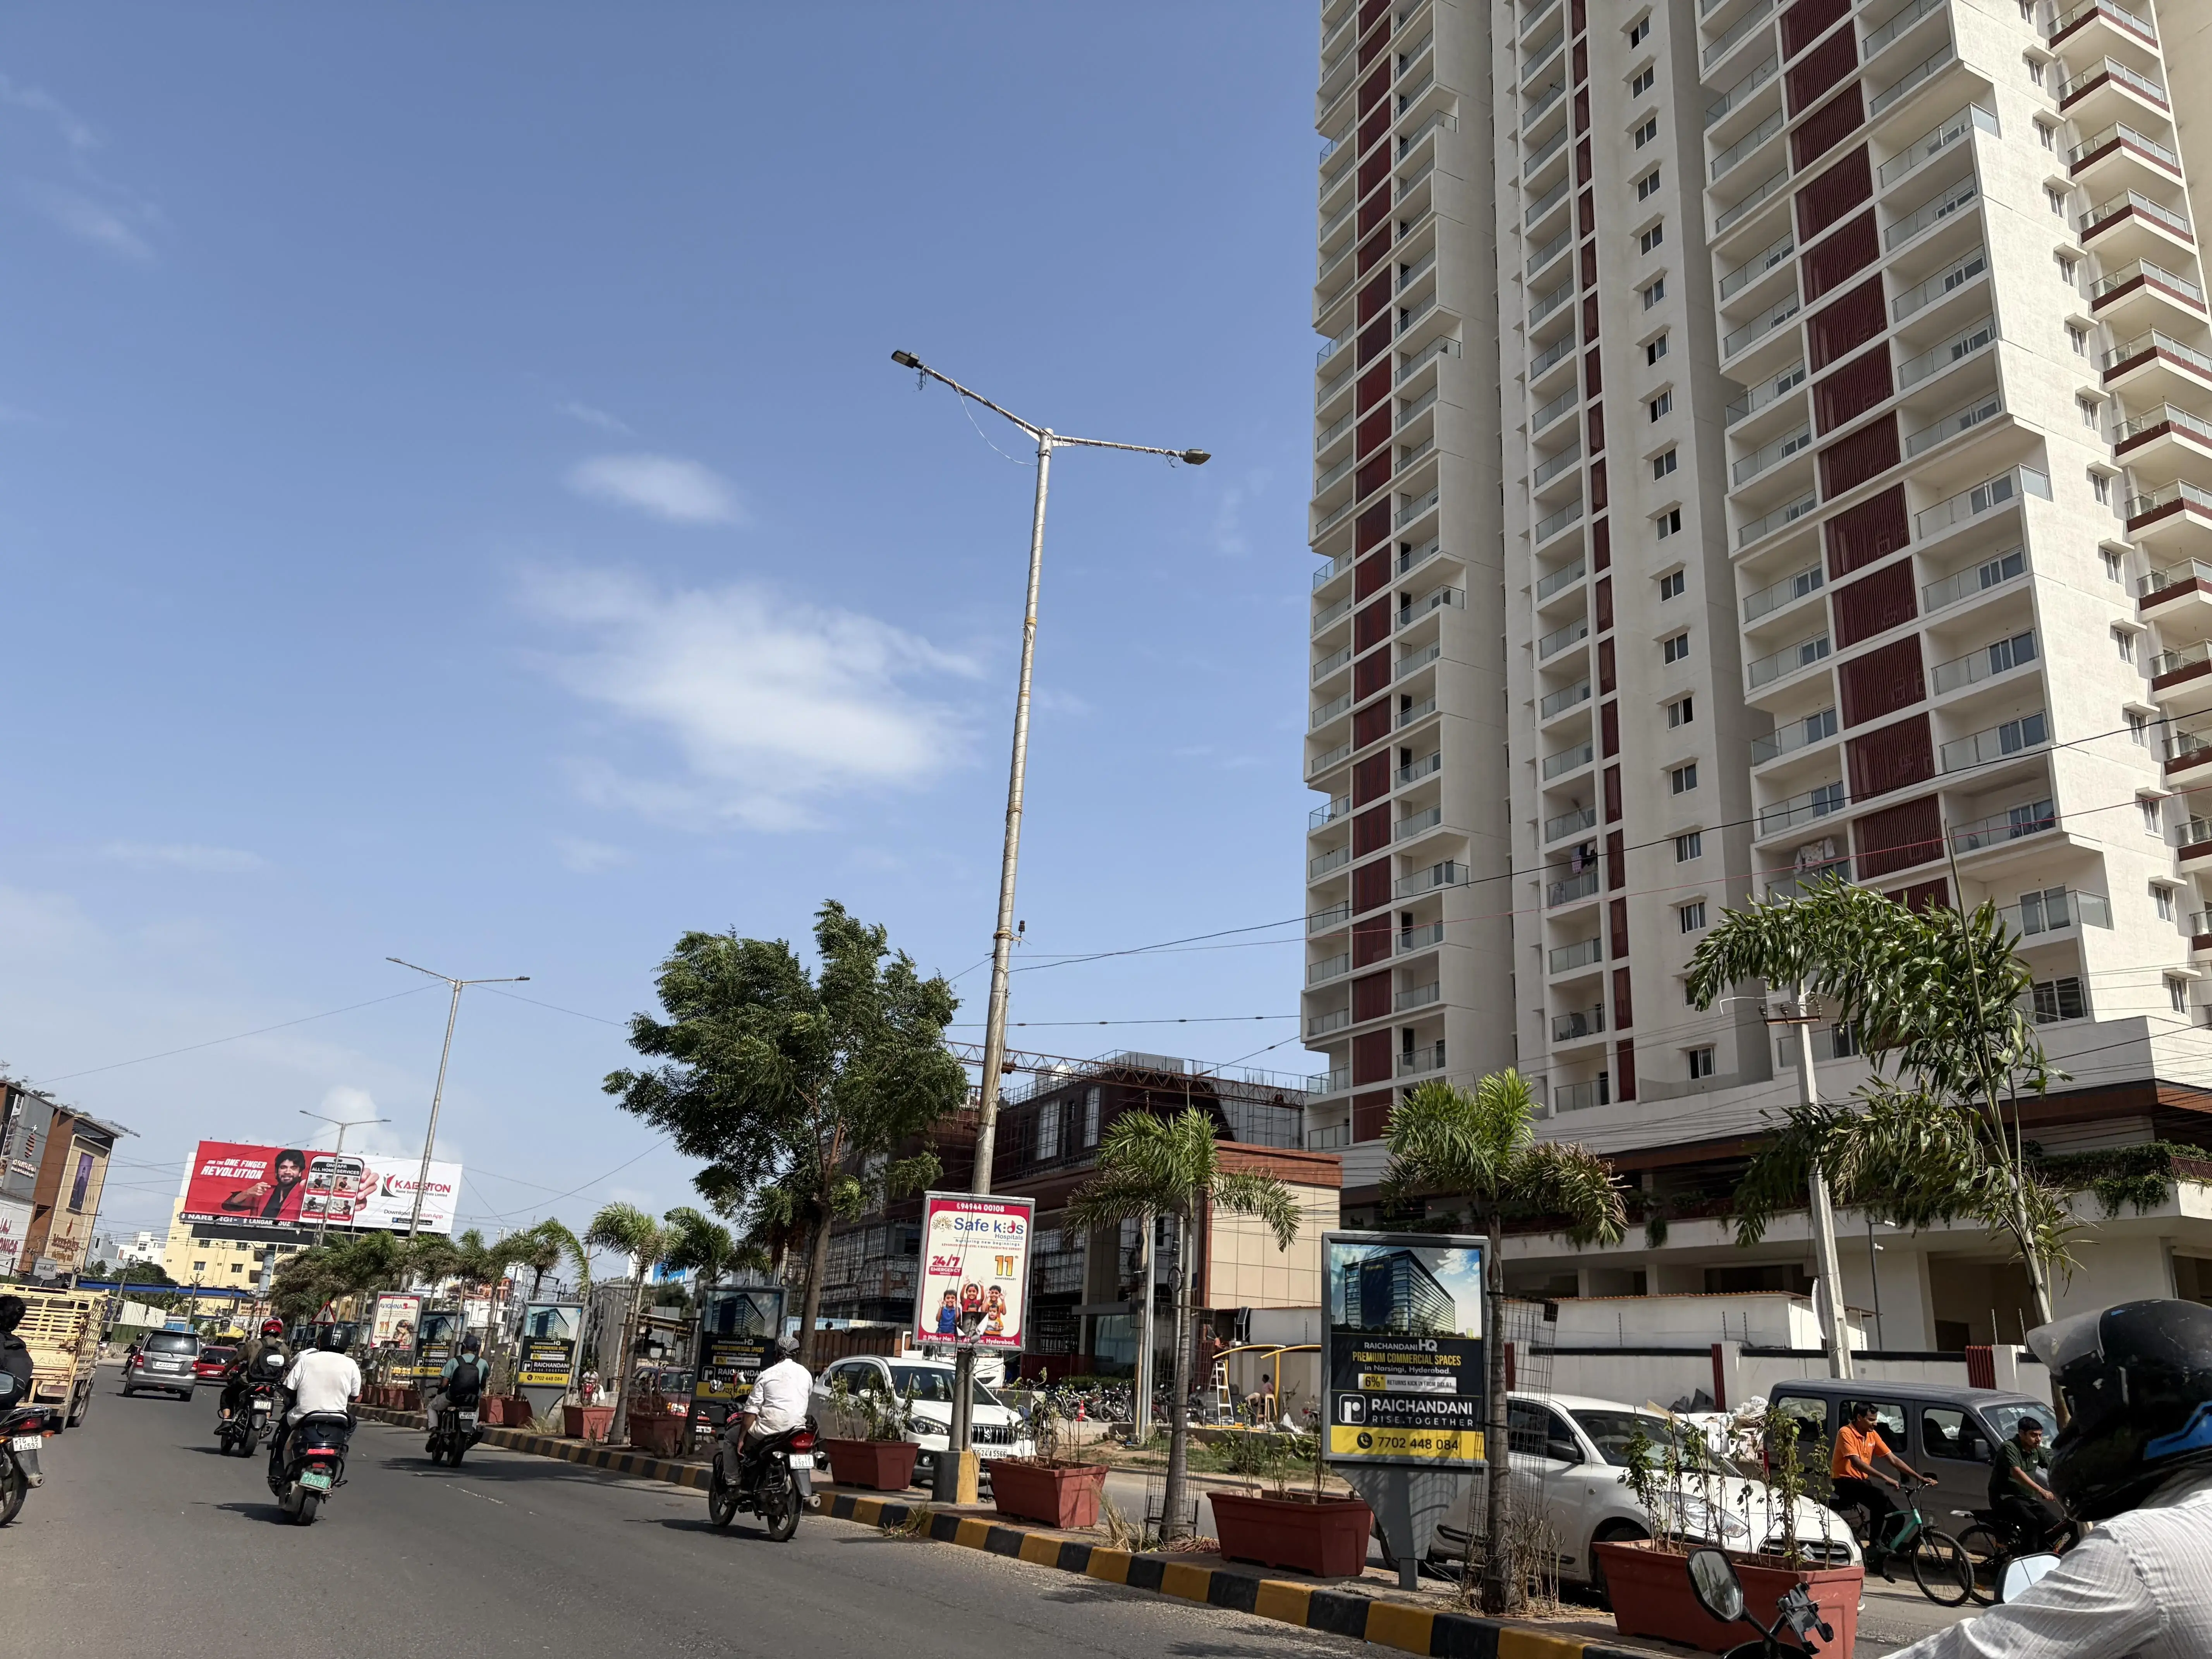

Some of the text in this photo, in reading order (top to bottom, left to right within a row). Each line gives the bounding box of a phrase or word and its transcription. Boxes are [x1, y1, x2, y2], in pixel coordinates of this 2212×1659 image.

[240, 1160, 267, 1169] FINGER
[200, 1166, 264, 1180] REVOLUTION
[188, 1214, 233, 1222] NARSNGI
[954, 1218, 989, 1231] Safe
[932, 1254, 960, 1267] 24/7
[995, 1255, 1013, 1276] 11
[1364, 1339, 1437, 1352] RAICHANDANI HQ
[1352, 1351, 1462, 1366] PREMIUM COMMERCIAL SPACES
[1374, 1365, 1407, 1373] Narsingi,
[1409, 1366, 1451, 1374] Hyderabad.
[1372, 1399, 1472, 1415] RAICHANDANI
[1378, 1437, 1458, 1450] 7702 448 084
